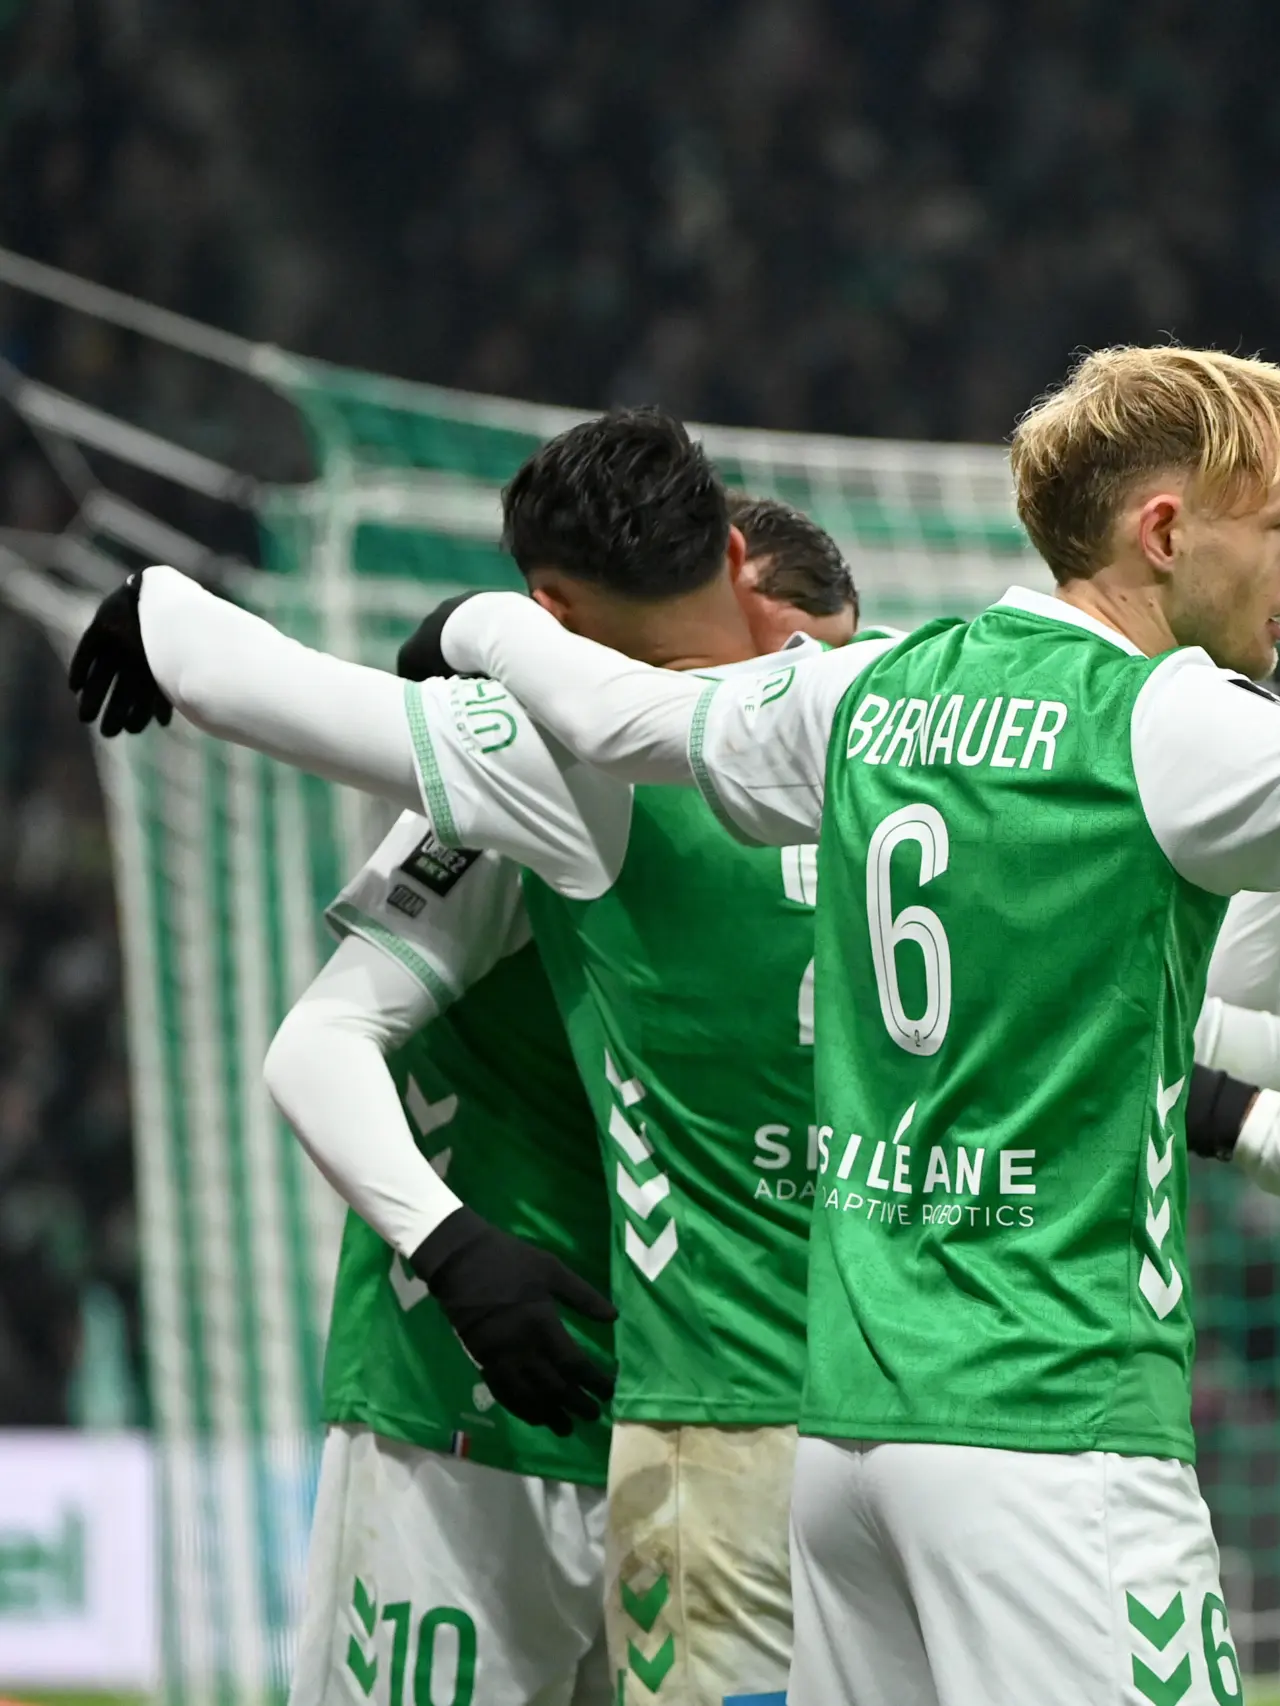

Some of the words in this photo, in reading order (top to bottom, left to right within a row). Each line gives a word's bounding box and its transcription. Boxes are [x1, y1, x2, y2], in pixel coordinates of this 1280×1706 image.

[846, 693, 1068, 770] BERNAUER
[866, 802, 952, 1057] 6
[754, 1177, 816, 1200] ADA
[822, 1186, 913, 1226] APTIVE
[381, 1601, 478, 1706] 10
[1200, 1591, 1244, 1706] 6
